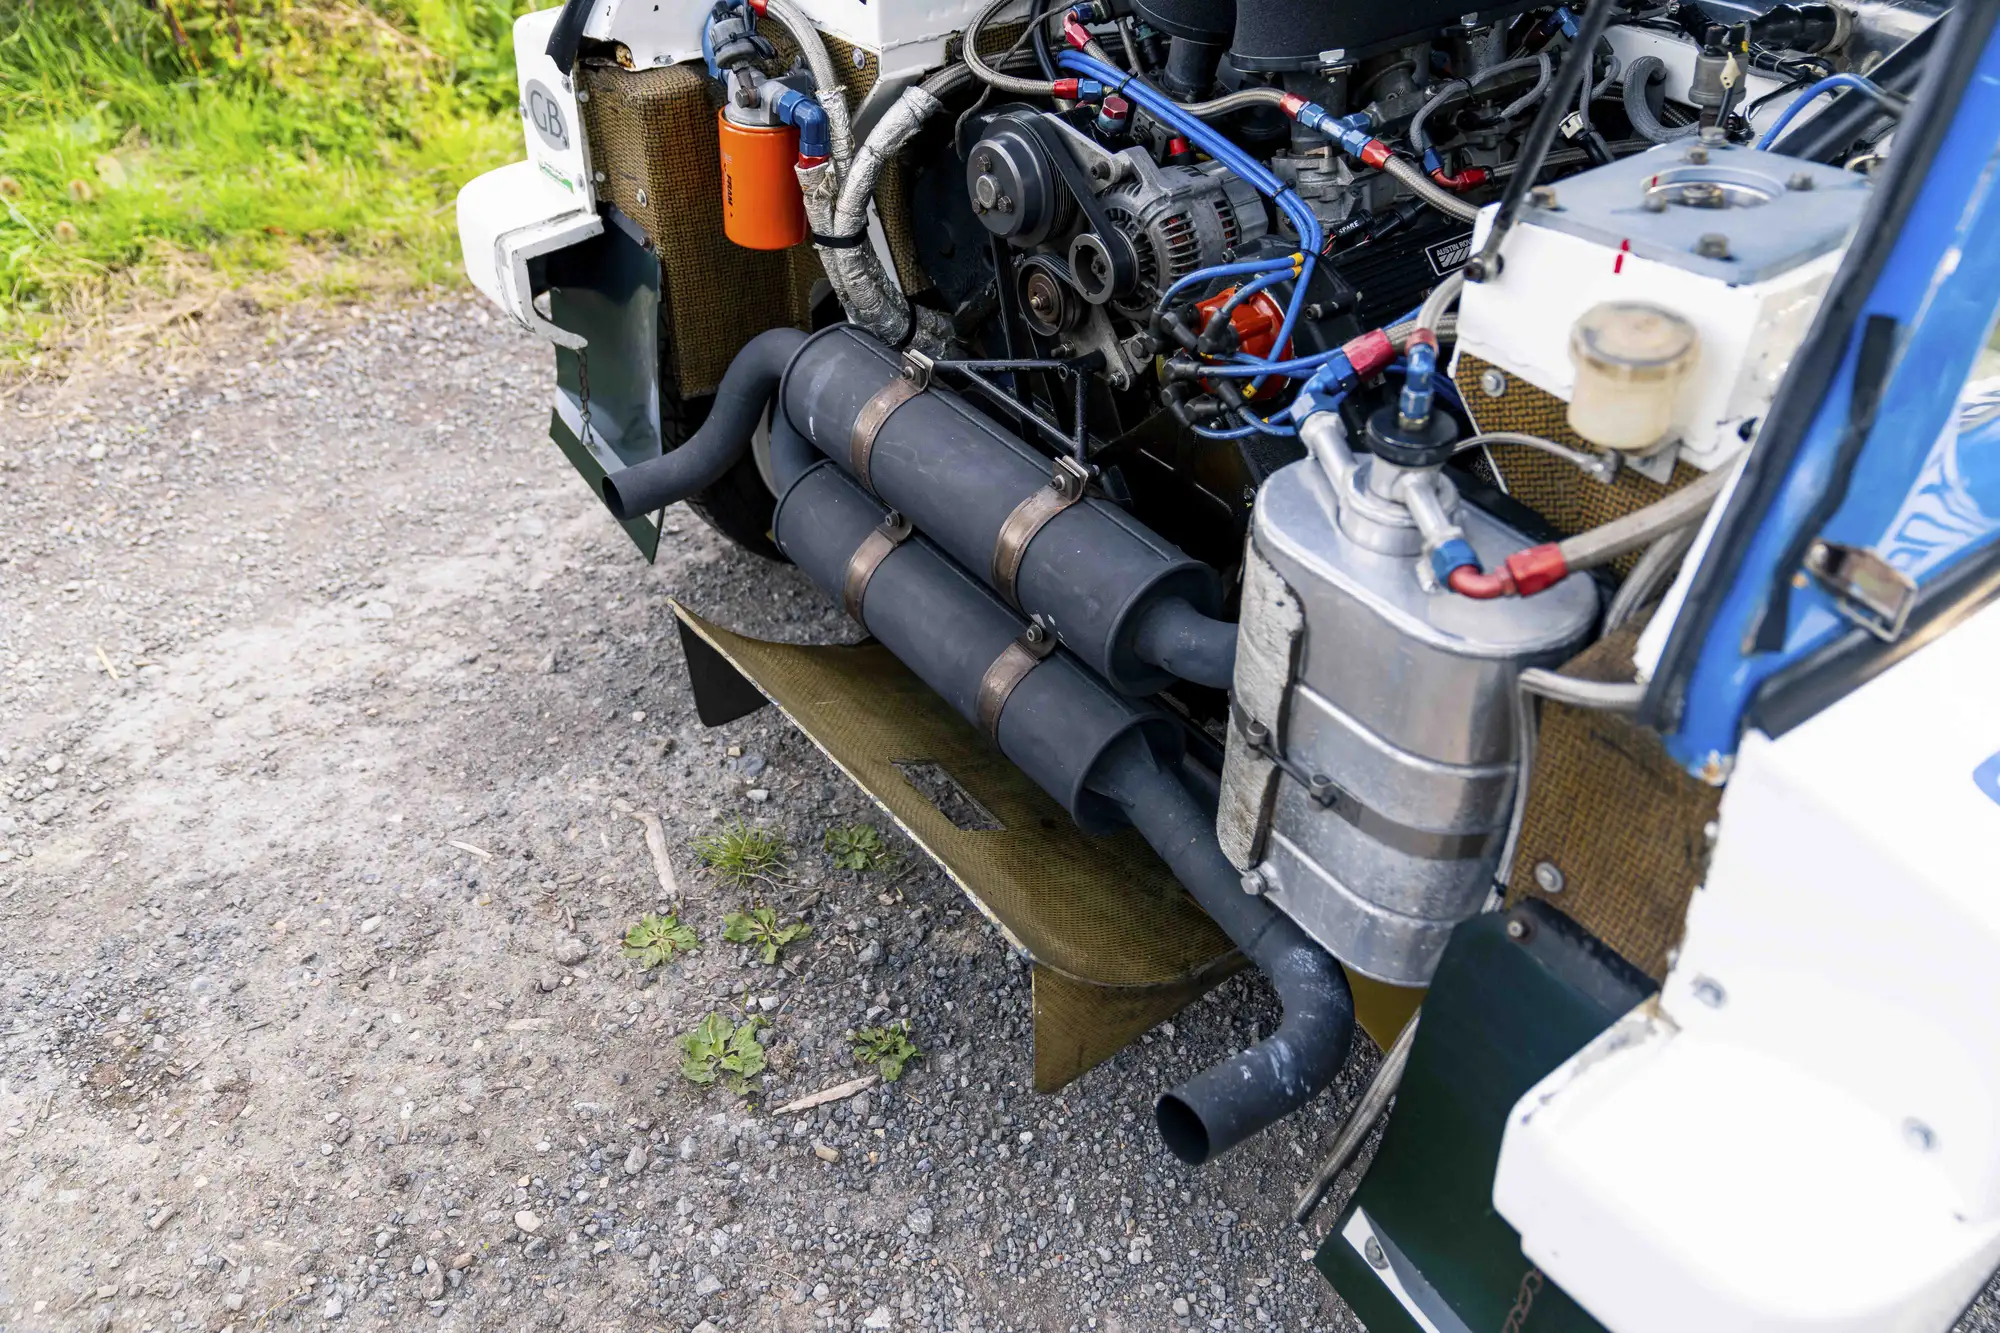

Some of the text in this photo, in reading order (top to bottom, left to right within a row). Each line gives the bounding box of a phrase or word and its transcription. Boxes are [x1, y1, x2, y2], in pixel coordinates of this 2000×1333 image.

[530, 89, 563, 138] GB
[1338, 219, 1360, 234] SPARE
[1436, 237, 1473, 257] AUSTIN ROV
